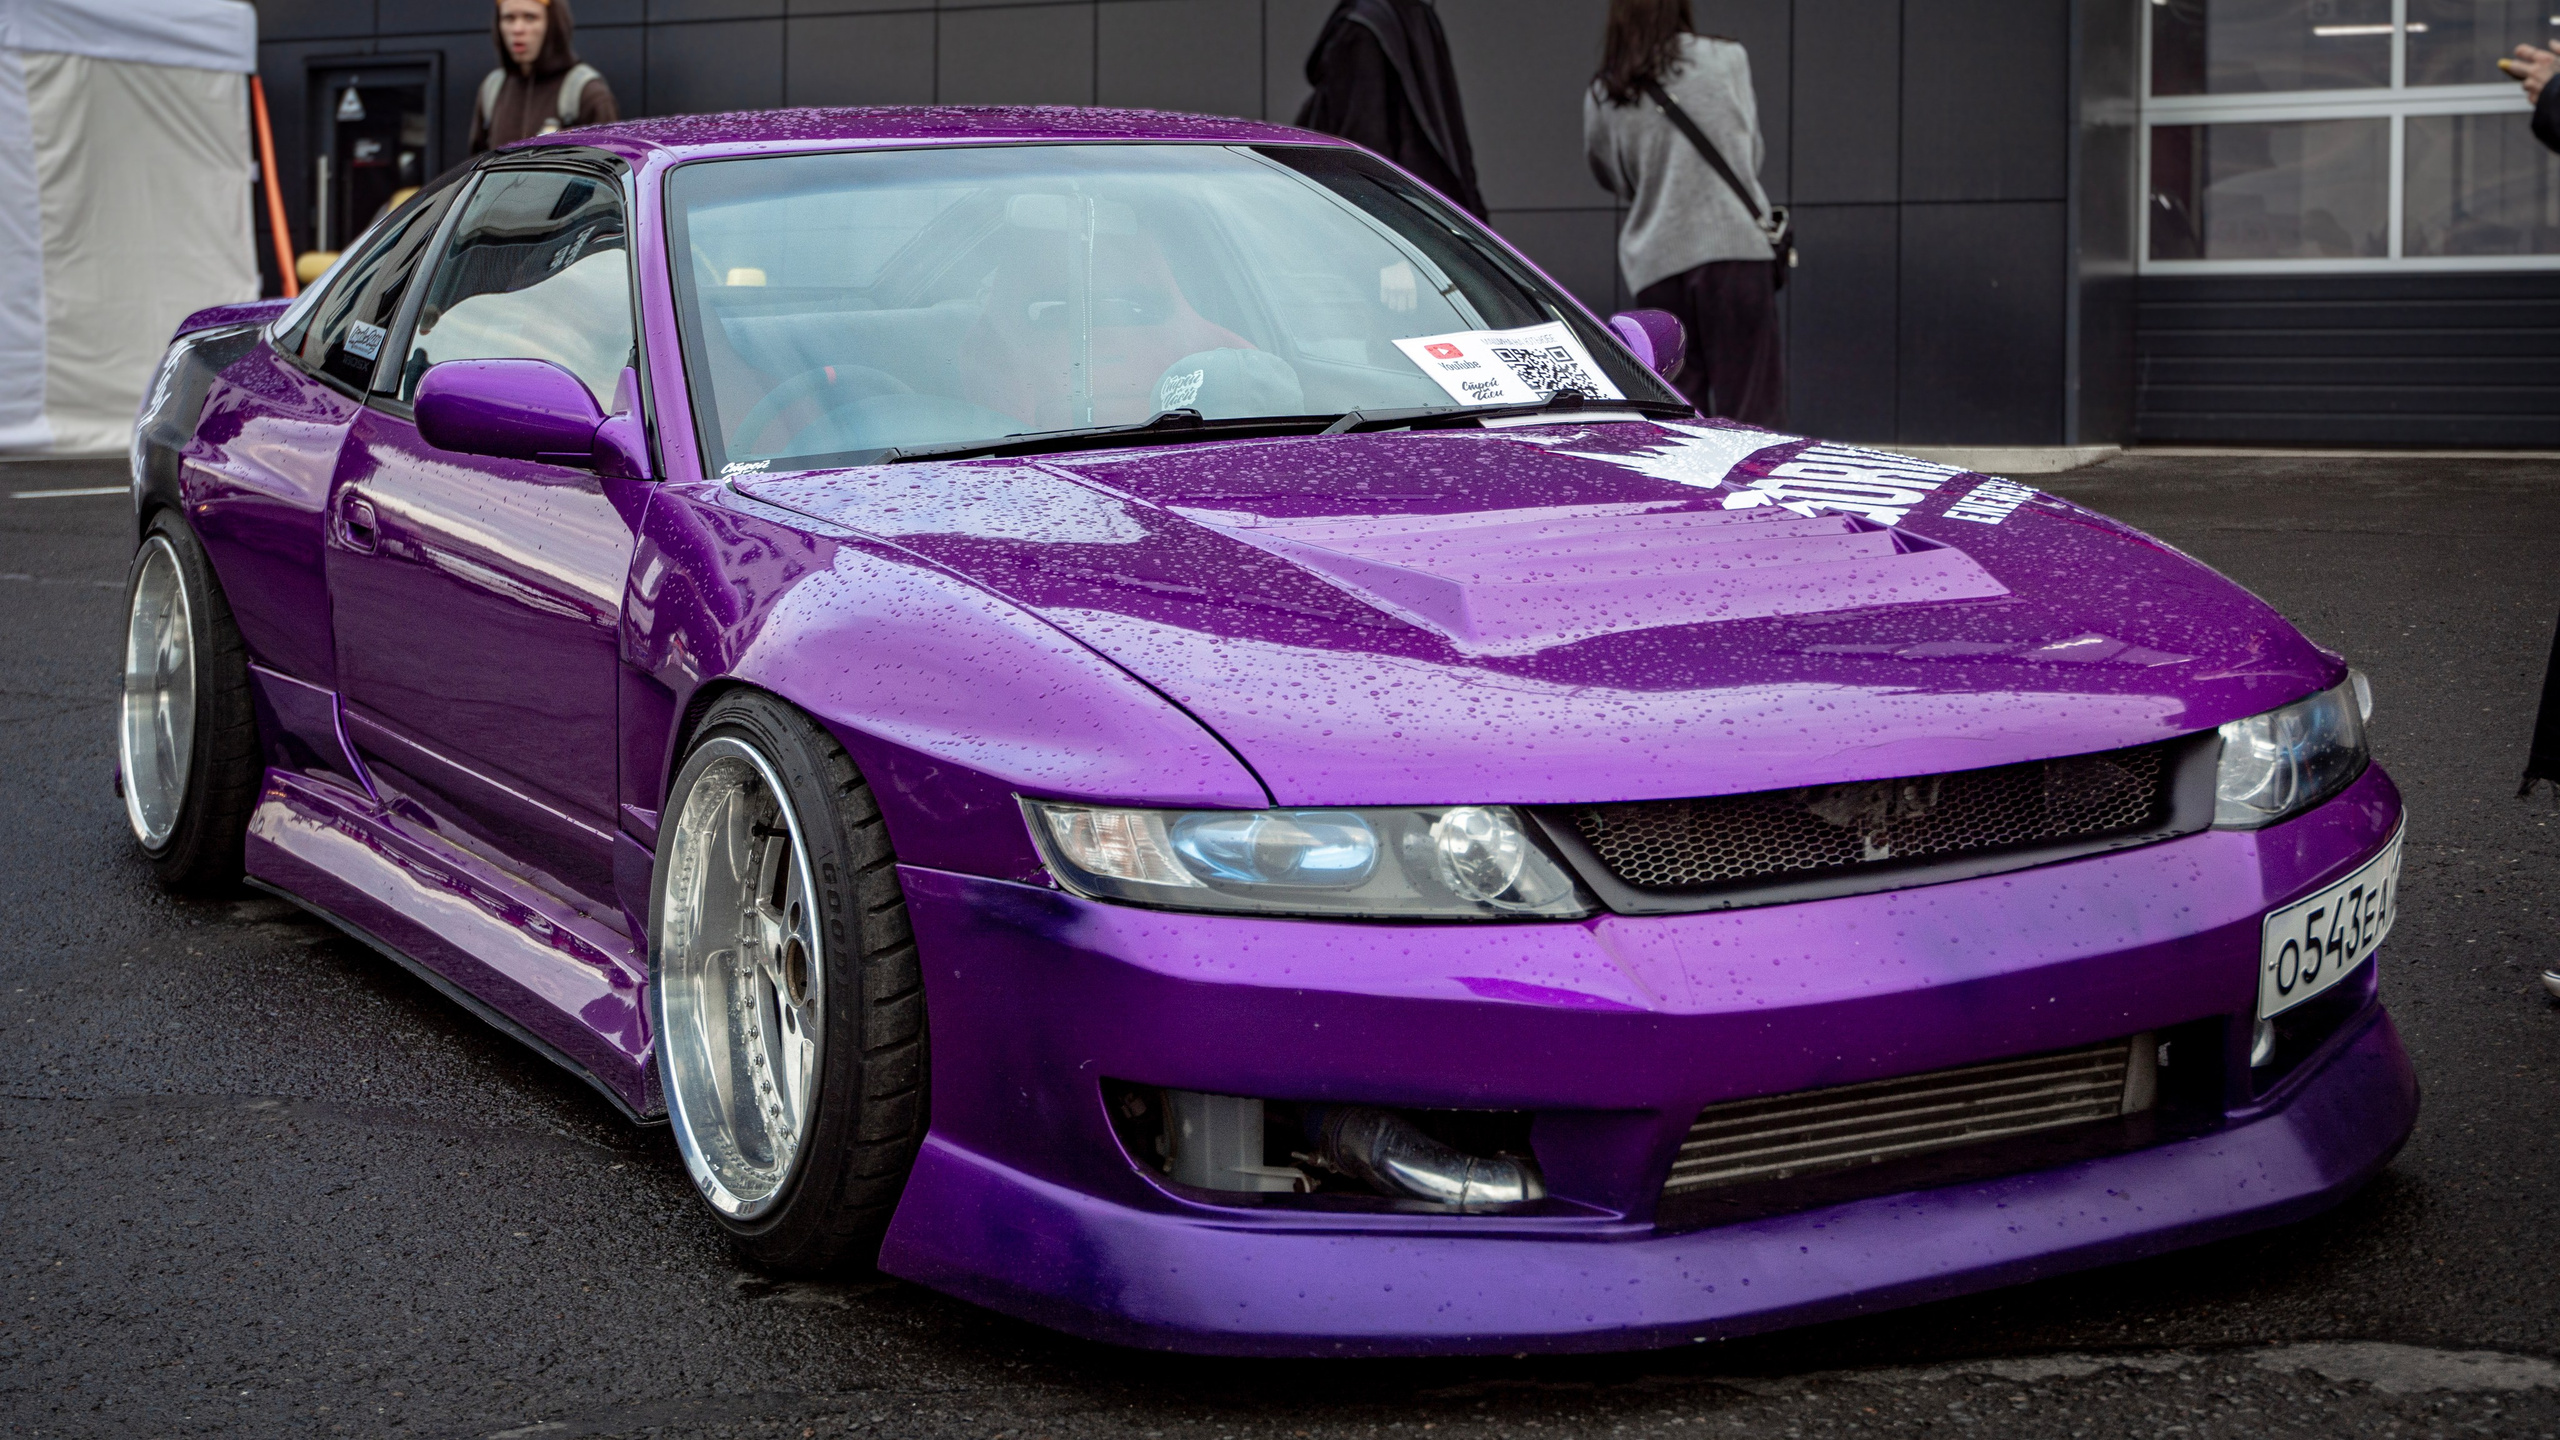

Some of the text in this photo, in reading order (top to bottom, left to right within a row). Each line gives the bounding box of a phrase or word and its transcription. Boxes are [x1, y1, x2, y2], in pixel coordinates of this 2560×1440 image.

[1438, 360, 1481, 371] YouTube
[1462, 377, 1499, 392] Строй
[1942, 476, 2040, 525] ENERGY
